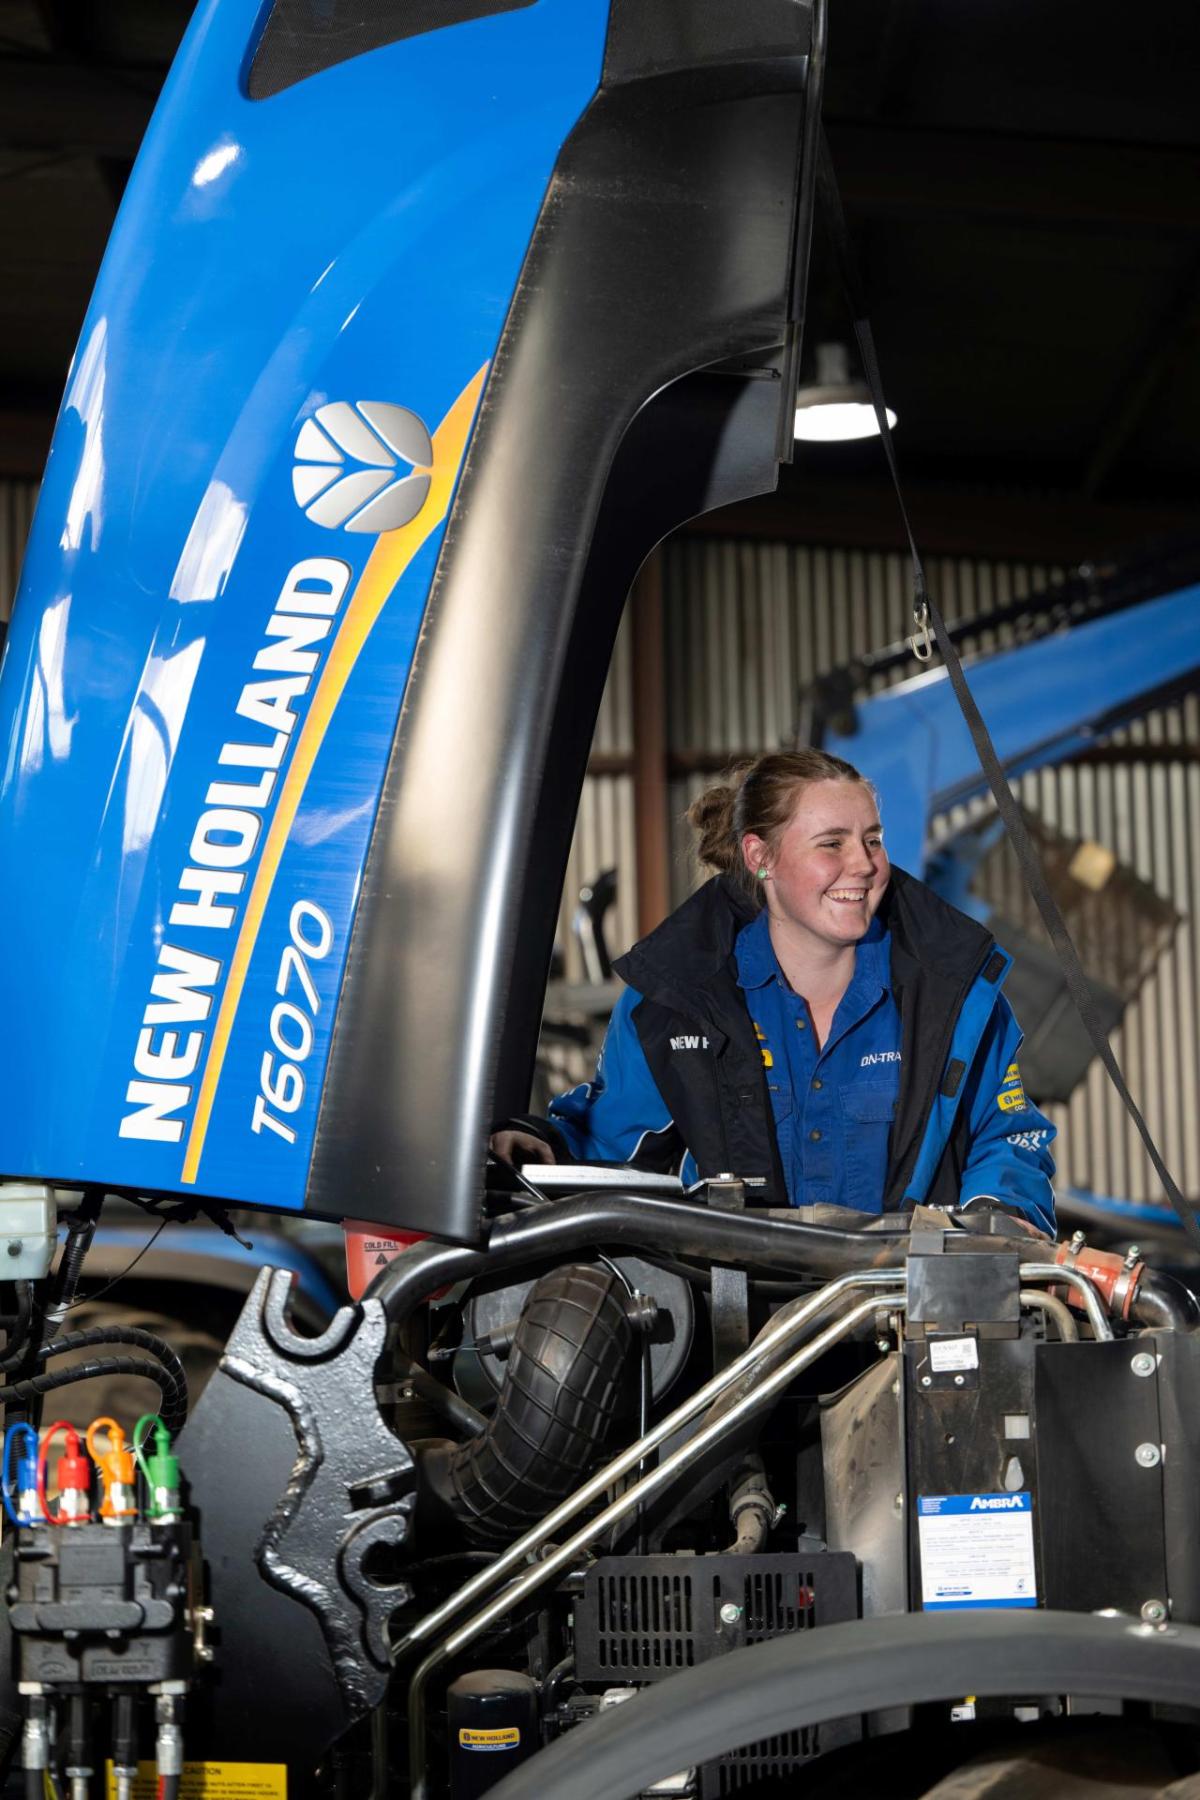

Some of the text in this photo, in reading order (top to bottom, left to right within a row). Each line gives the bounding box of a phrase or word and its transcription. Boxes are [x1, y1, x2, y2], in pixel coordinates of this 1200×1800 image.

[118, 557, 352, 1144] NEW HOLLAND
[251, 900, 334, 1144] T6070
[670, 1035, 700, 1050] NEW
[970, 1496, 1024, 1510] AMBRA
